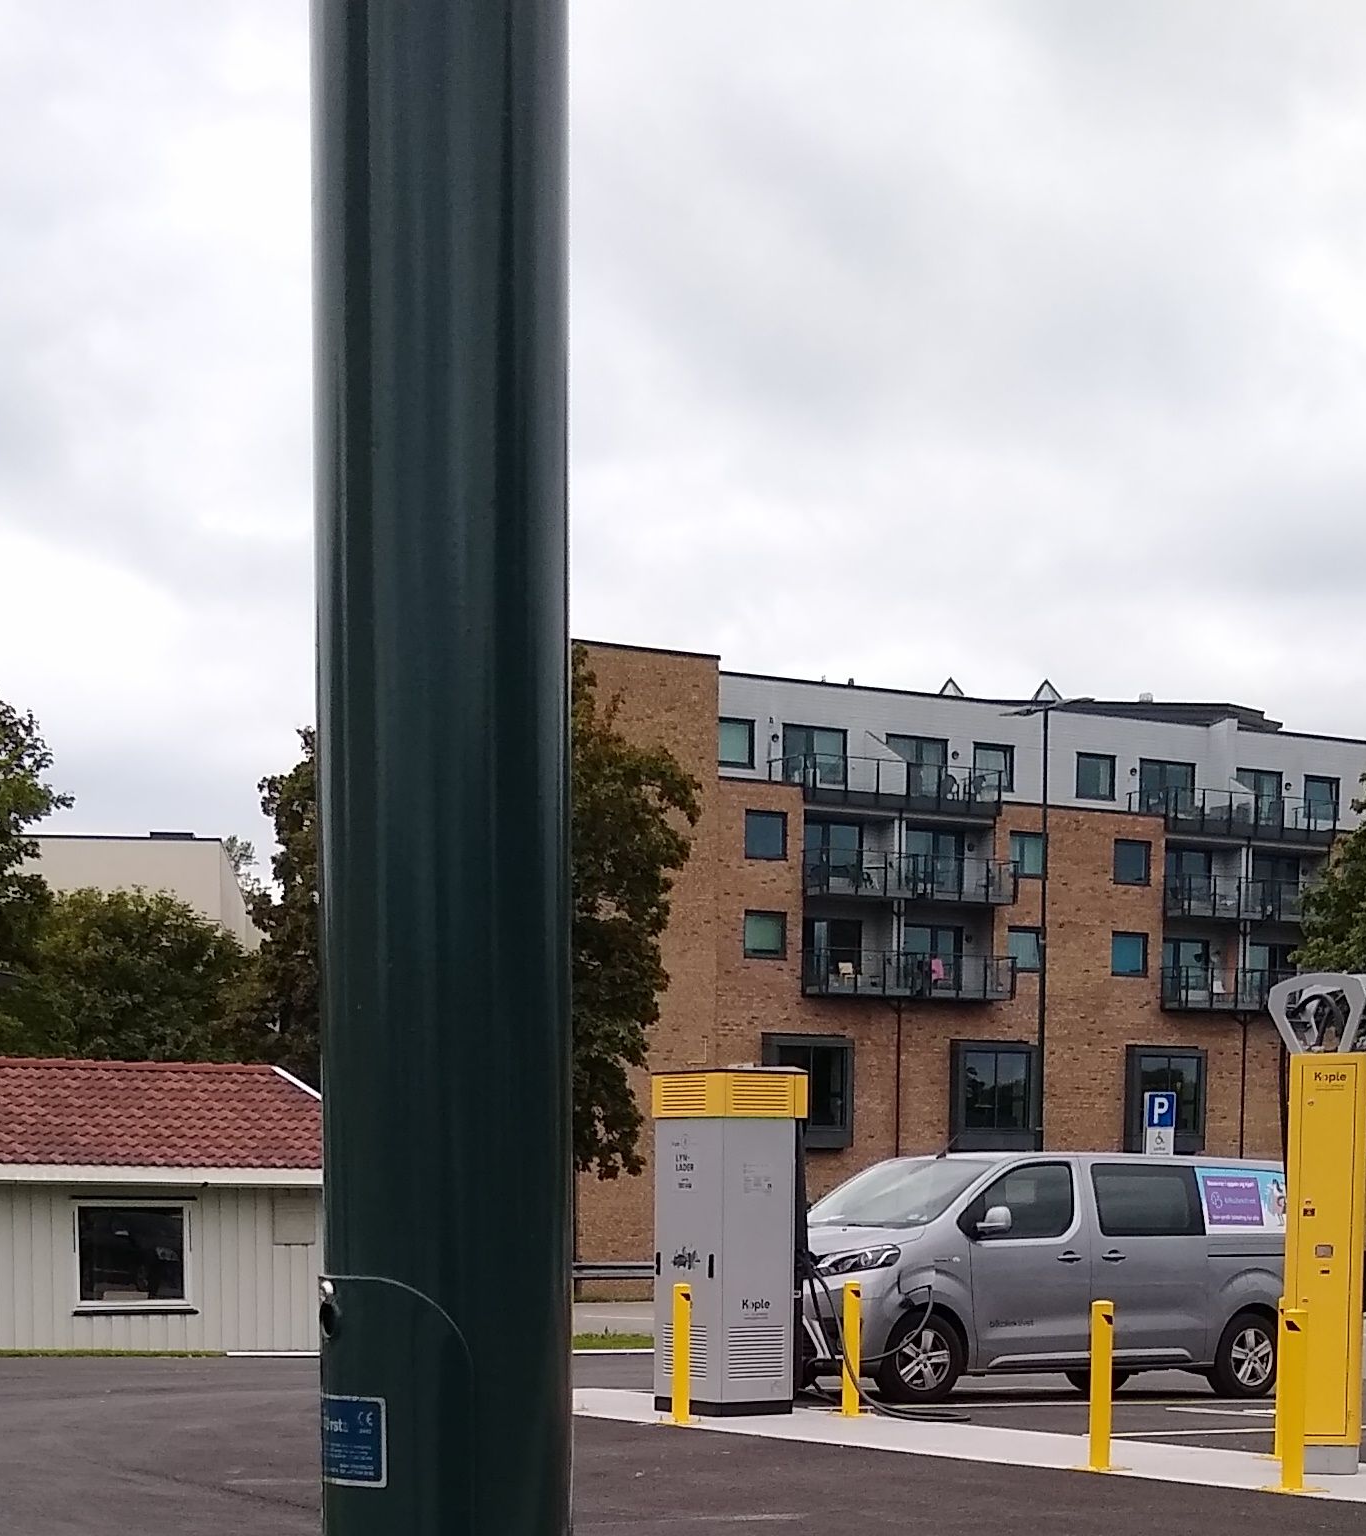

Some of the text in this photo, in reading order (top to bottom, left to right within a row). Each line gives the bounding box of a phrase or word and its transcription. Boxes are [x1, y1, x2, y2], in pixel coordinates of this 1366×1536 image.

[1314, 1071, 1347, 1083] Kople
[1153, 1097, 1169, 1124] P
[741, 1298, 771, 1312] Kople
